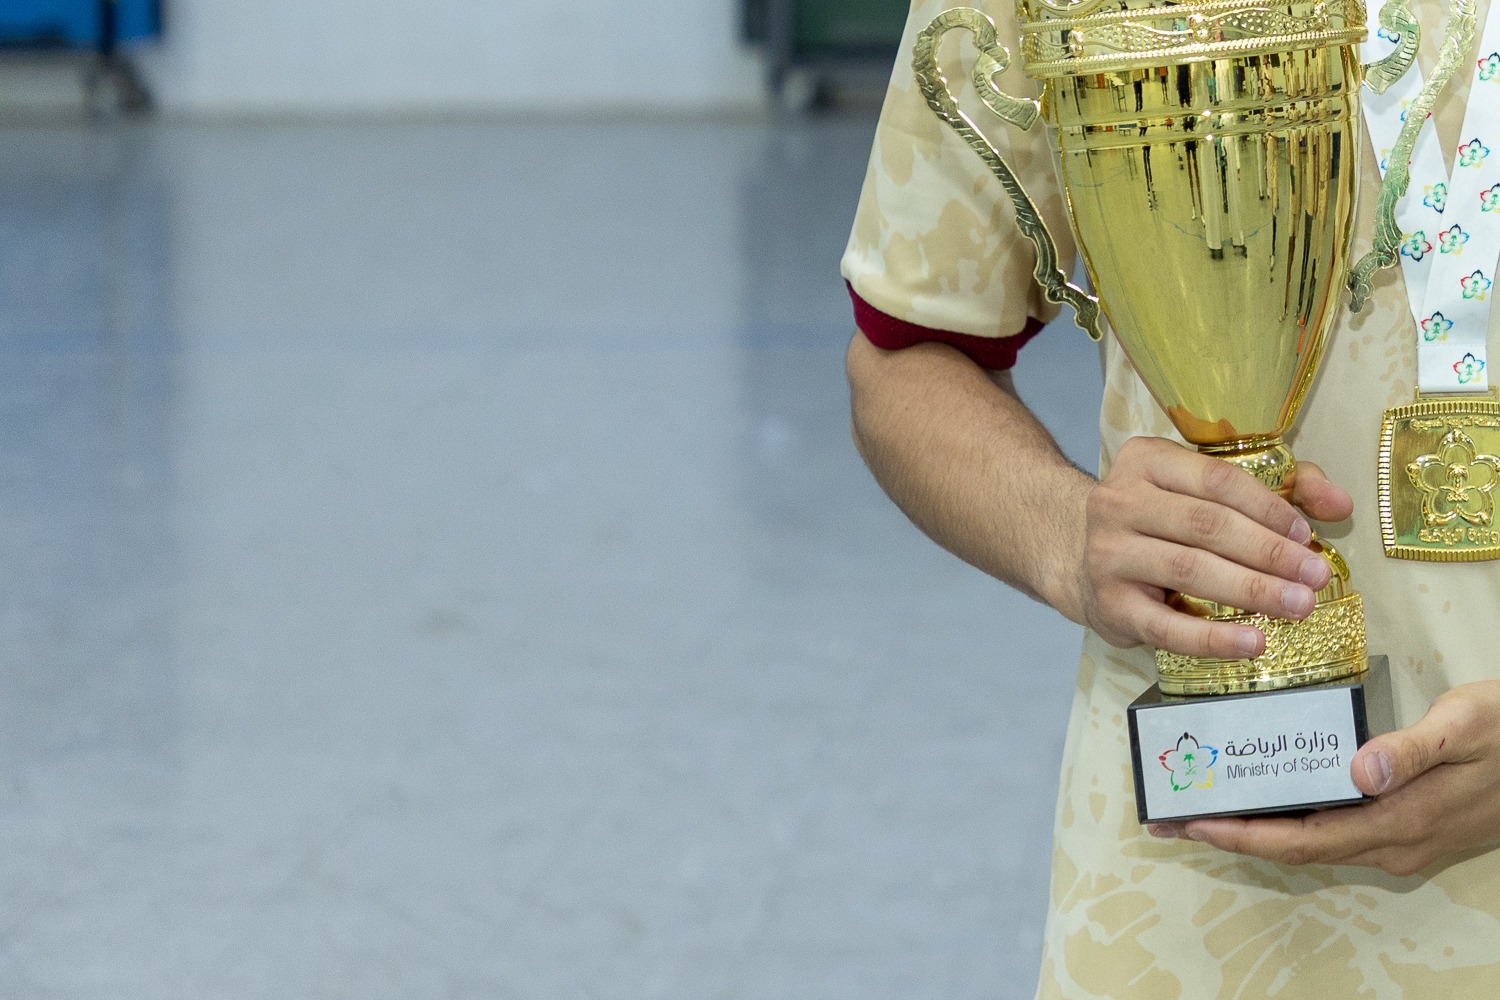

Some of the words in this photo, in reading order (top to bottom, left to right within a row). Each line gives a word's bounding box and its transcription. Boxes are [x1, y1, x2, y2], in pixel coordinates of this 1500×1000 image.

[1225, 734, 1287, 758] الرياضة
[1295, 731, 1338, 753] وزارة
[1227, 762, 1279, 779] Ministry
[1283, 758, 1296, 773] of
[1300, 754, 1340, 773] Sport
